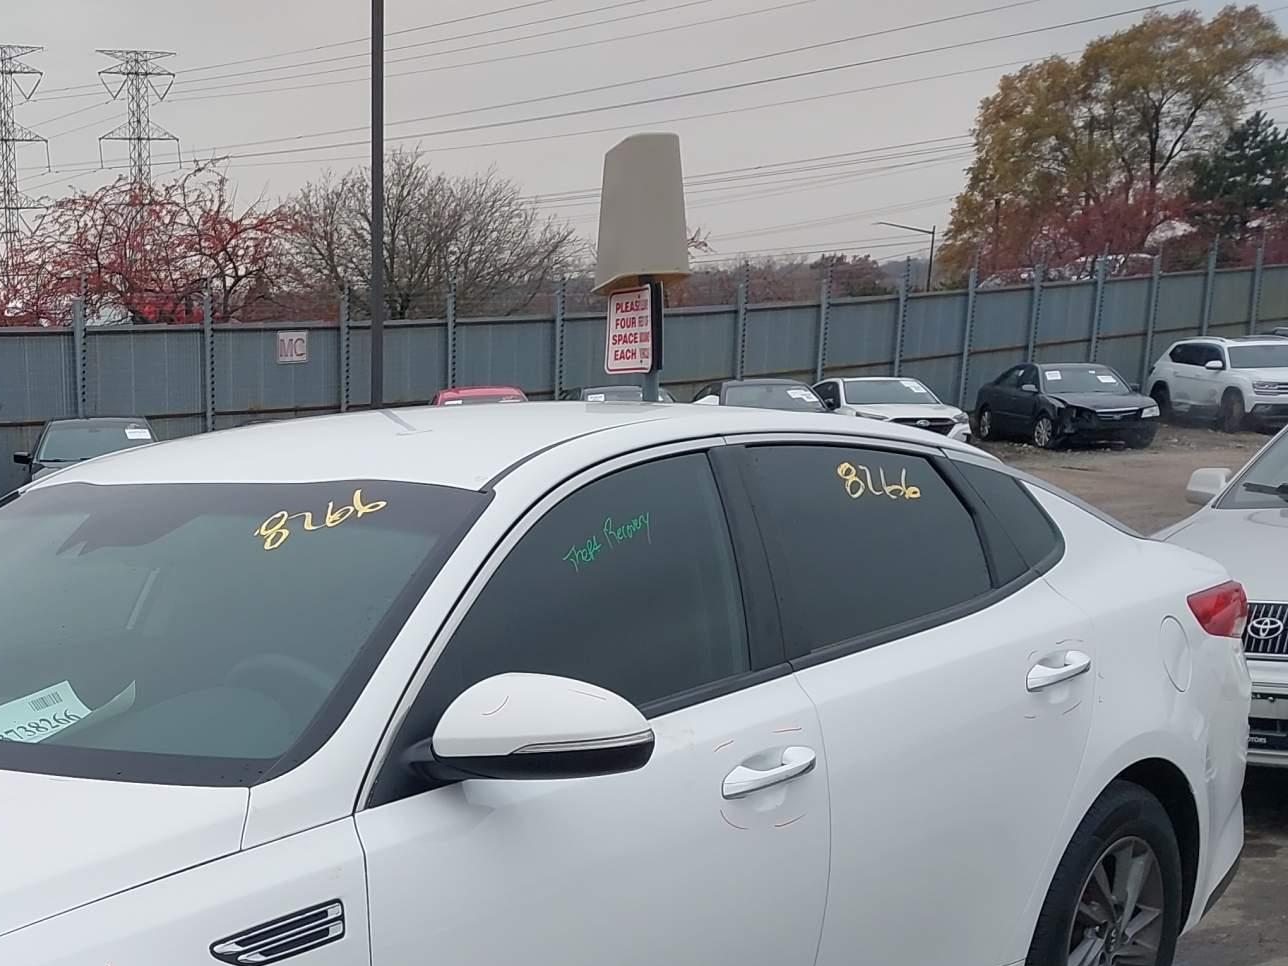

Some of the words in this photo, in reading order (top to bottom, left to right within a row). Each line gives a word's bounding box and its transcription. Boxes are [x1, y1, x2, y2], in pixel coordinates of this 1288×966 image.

[615, 317, 637, 330] FOUR
[279, 337, 305, 357] MC
[612, 332, 639, 346] SPACE
[614, 348, 637, 361] EACH
[837, 462, 921, 500] 8266
[253, 488, 388, 550] 8266
